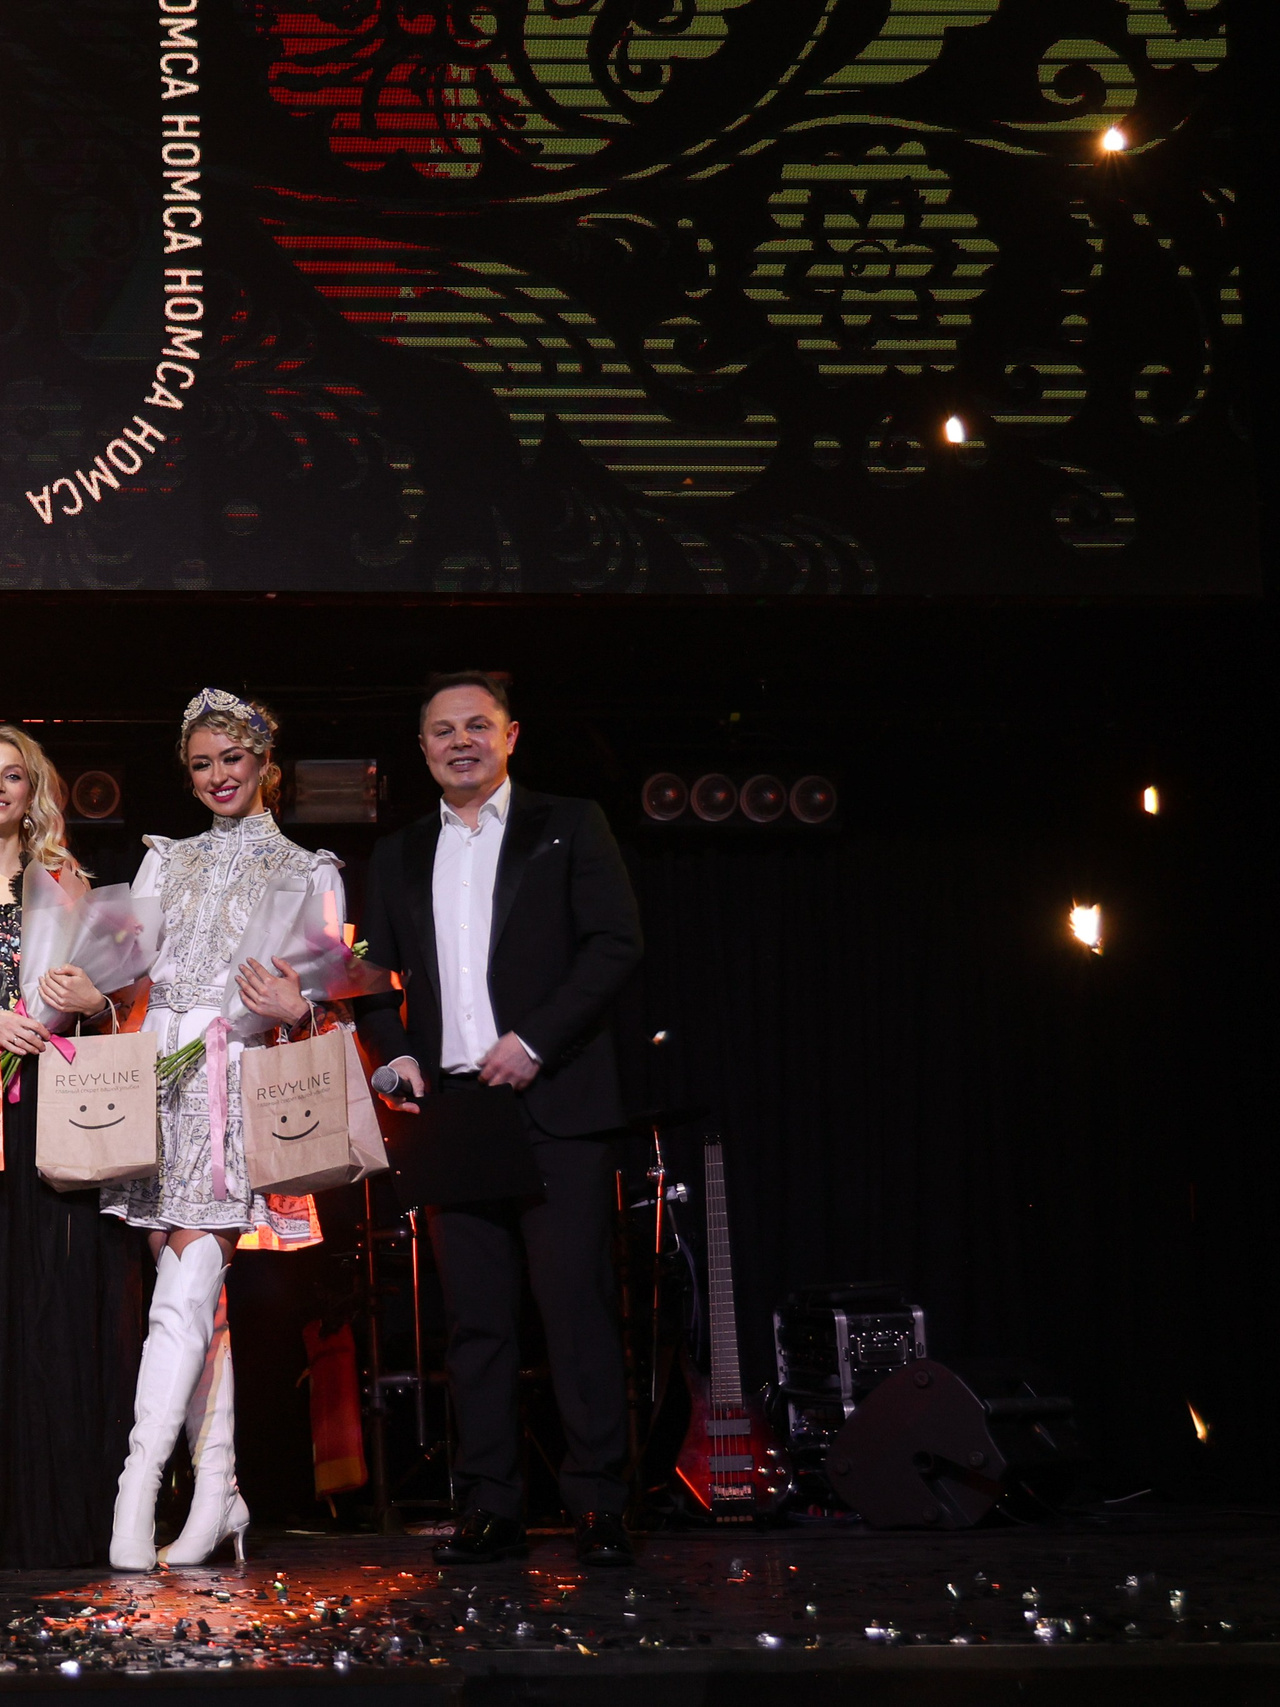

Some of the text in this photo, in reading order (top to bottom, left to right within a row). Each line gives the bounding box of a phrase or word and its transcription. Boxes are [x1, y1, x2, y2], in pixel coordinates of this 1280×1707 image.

[160, 114, 202, 254] НОМСА
[143, 269, 204, 410] НОМСА
[24, 415, 166, 525] НОМСА
[55, 1069, 140, 1087] REVYLINE
[256, 1071, 331, 1101] REVYLINE
